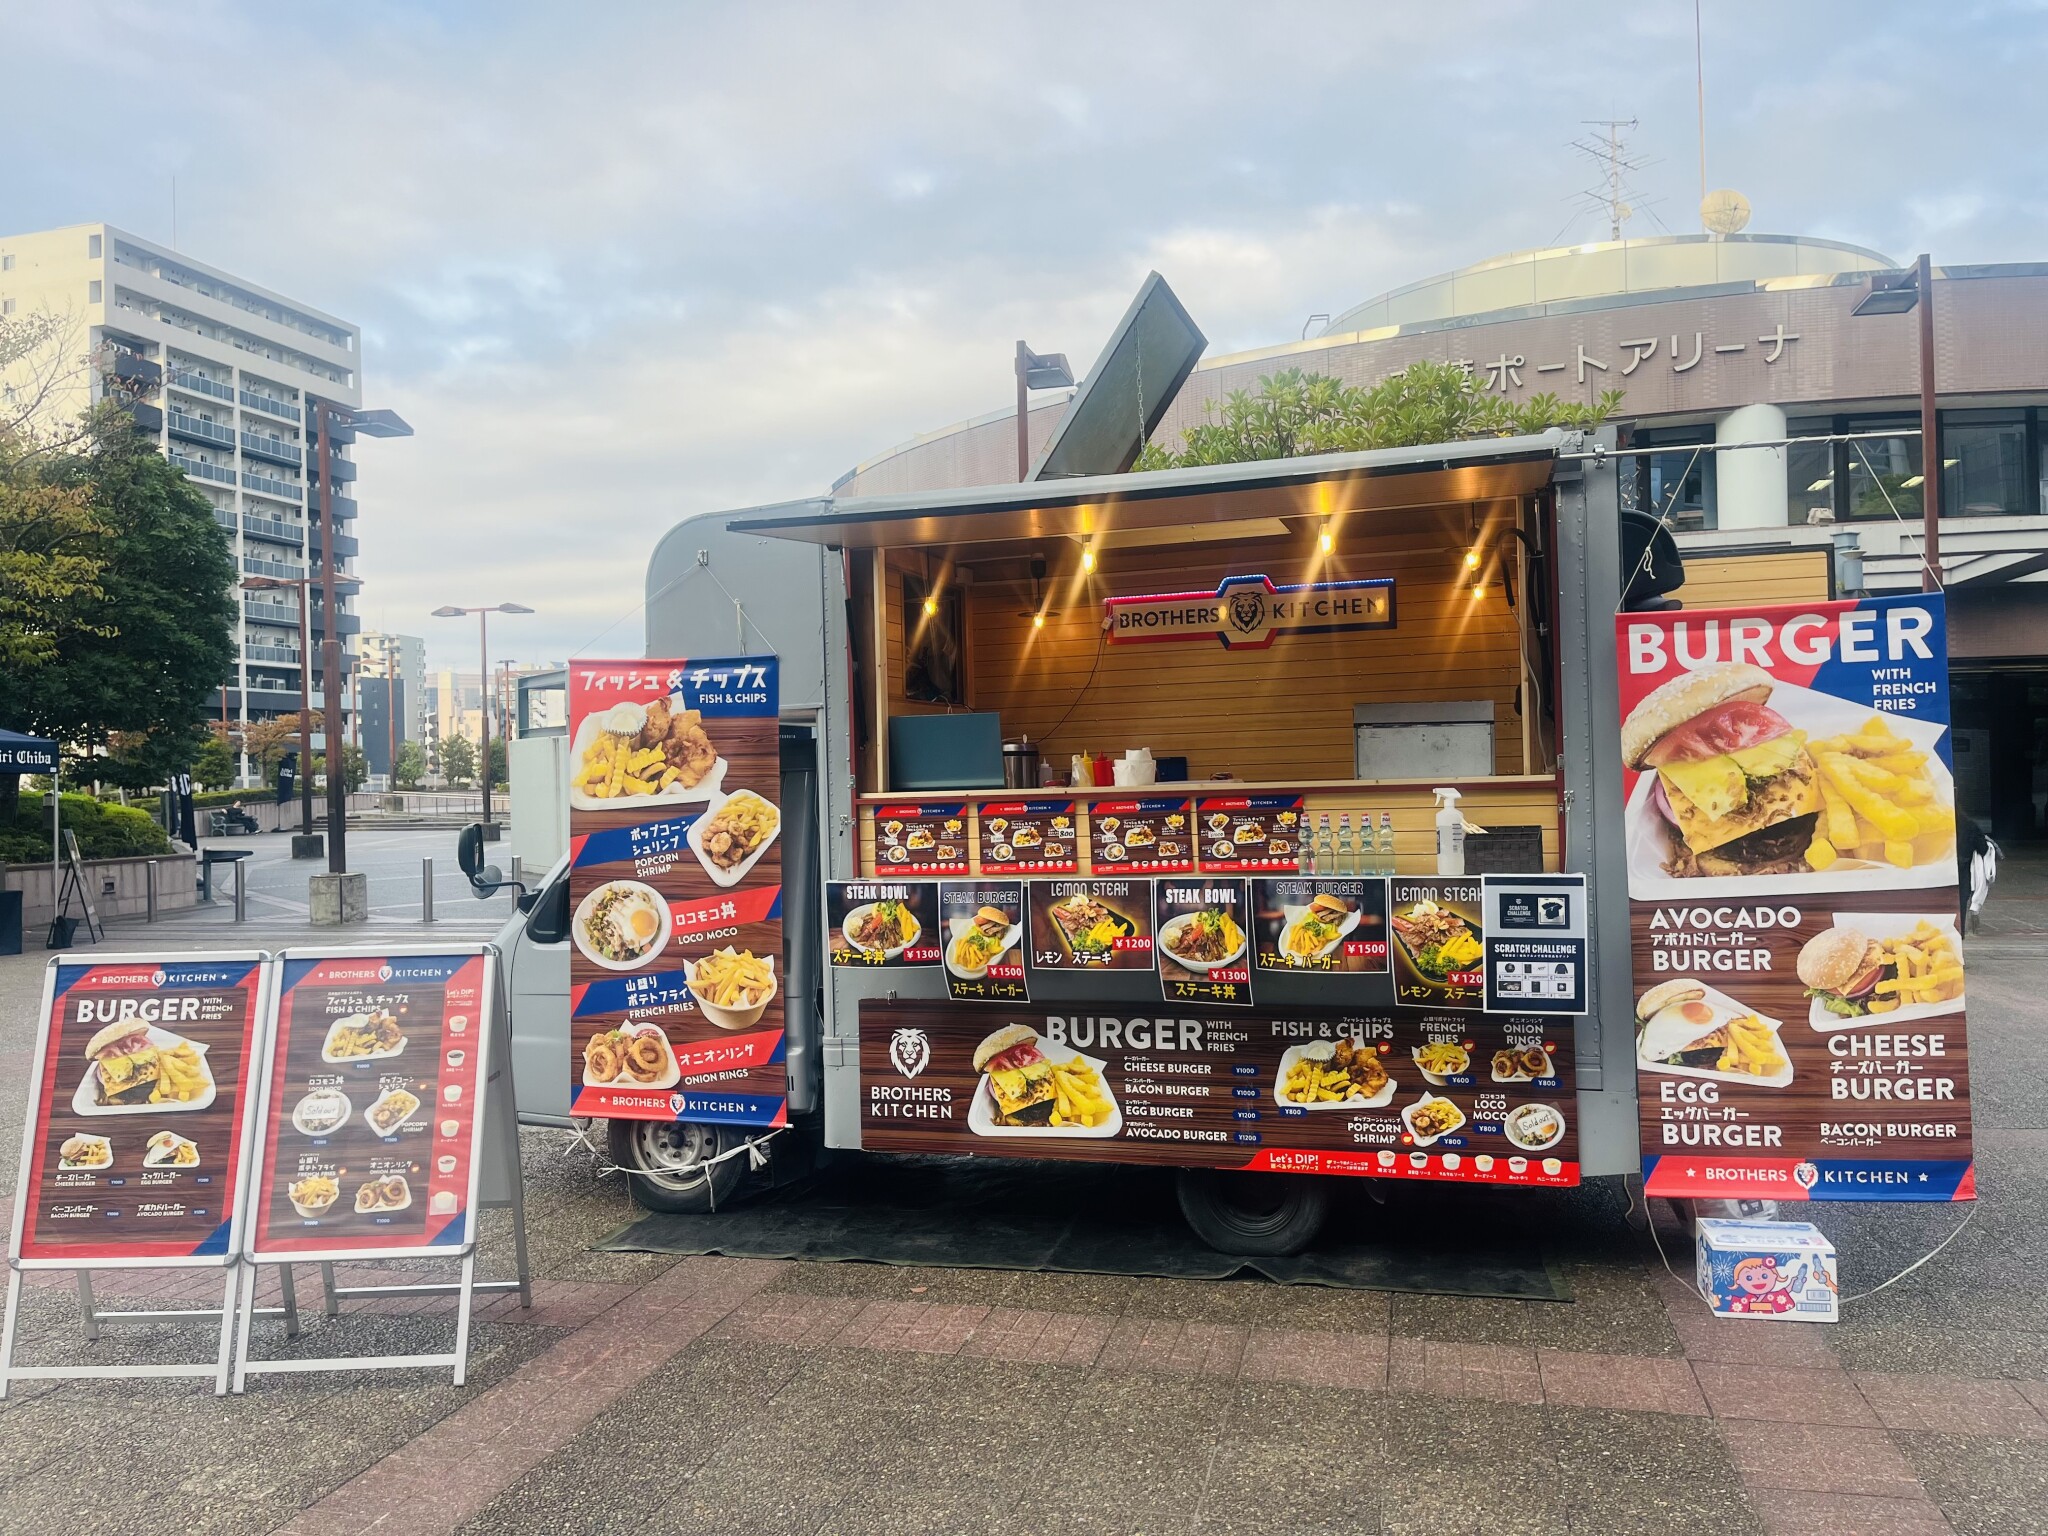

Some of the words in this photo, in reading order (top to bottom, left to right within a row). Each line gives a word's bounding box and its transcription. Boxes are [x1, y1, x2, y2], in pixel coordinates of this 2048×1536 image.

[1390, 324, 1799, 399] ポートアリーナ
[1119, 608, 1220, 629] BROTHERS
[1273, 597, 1384, 619] KITCHEN
[1628, 606, 1934, 674] BURGER
[580, 671, 660, 691] フィッシュ
[666, 669, 684, 689] &
[690, 665, 767, 689] チップス
[1871, 667, 1911, 681] WITH
[1872, 681, 1937, 696] FRENCH
[699, 694, 723, 704] FISH
[725, 694, 733, 703] &
[734, 693, 767, 703] CHIPS
[1873, 697, 1916, 711] FRIES
[16, 750, 52, 764] Chiba
[630, 820, 690, 841] ポップコーン
[633, 836, 680, 856] シュリンプ
[635, 852, 679, 868] POPCORN
[637, 864, 672, 878] SHRIMP
[846, 885, 878, 900] STEAK
[880, 886, 909, 900] BOWL
[1051, 882, 1087, 897] LEMON
[1093, 882, 1129, 897] STEAK
[1166, 888, 1202, 904] STEAK
[1204, 888, 1237, 904] BOWL
[1276, 882, 1313, 895] STEAK
[1315, 882, 1364, 895] BURGER
[943, 891, 975, 904] STEAK
[977, 891, 1019, 903] BURGER
[676, 901, 737, 926] ロコモコ丼
[1649, 906, 1802, 930] AVOCADO
[678, 933, 704, 944] LOCO
[706, 927, 738, 941] MOCO
[1650, 932, 1757, 947] アボカドバーガー
[1494, 943, 1531, 954] SCRATCH
[1532, 944, 1577, 954] CHALLENGE
[832, 949, 886, 965] ステーキ丼
[1036, 950, 1063, 964] レモン
[1072, 950, 1112, 965] ステーキ
[1259, 952, 1296, 969] ステーキ
[1302, 953, 1341, 970] バーガー
[1652, 949, 1772, 971] BURGER
[102, 975, 149, 984] BROTHERS
[168, 974, 217, 983] KITCHEN
[329, 970, 375, 979] BROTHERS
[395, 969, 442, 977] KITCHEN
[1451, 973, 1482, 983] ¥120
[626, 976, 658, 992] 山盛り
[953, 983, 985, 996] ステーキ
[991, 984, 1024, 997] バーガー
[1175, 983, 1236, 1000] ステーキ丼
[1400, 985, 1431, 998] レモン
[327, 994, 364, 1005] フィッシュ
[366, 994, 374, 1004] &
[376, 994, 409, 1004] チップス
[628, 986, 688, 1007] ポテトフライ
[76, 997, 200, 1023] BURGER
[202, 1004, 233, 1012] FRENCH
[326, 1006, 345, 1014] FISH
[346, 1005, 354, 1013] &
[355, 1005, 382, 1013] CHIPS
[629, 1006, 667, 1020] FRENCH
[668, 1001, 695, 1014] FRIES
[201, 1012, 222, 1020] FRIES
[1206, 1020, 1232, 1030] WITH
[1271, 1021, 1313, 1036] FISH
[1318, 1022, 1332, 1037] &
[1336, 1022, 1394, 1039] CHIPS
[1420, 1022, 1466, 1033] FRENCH
[1503, 1024, 1544, 1034] ONION
[1046, 1017, 1204, 1051] BURGER
[1206, 1031, 1248, 1042] FRENCH
[1428, 1034, 1459, 1043] FRIES
[1506, 1035, 1542, 1045] RINGS
[1207, 1042, 1235, 1052] FRIES
[1828, 1034, 1946, 1057] CHEESE
[679, 1043, 755, 1067] オニオンリング
[1124, 1062, 1165, 1073] CHEESE
[1167, 1064, 1212, 1074] BURGER
[1830, 1061, 1924, 1075] チーズバーガー
[684, 1073, 718, 1086] ONION
[719, 1068, 749, 1081] RINGS
[871, 1086, 951, 1102] BROTHERS
[1125, 1084, 1163, 1095] BACON
[1166, 1085, 1210, 1096] BURGER
[1660, 1081, 1719, 1104] EGG
[1831, 1078, 1955, 1101] BURGER
[304, 1104, 322, 1115] Sold
[612, 1096, 666, 1109] BROTHERS
[689, 1101, 744, 1112] KITCHEN
[871, 1104, 953, 1119] KITCHEN
[1474, 1100, 1507, 1109] LOCO
[1126, 1106, 1148, 1116] EGG
[1149, 1107, 1194, 1118] BURGER
[1473, 1111, 1509, 1121] MOCO
[1660, 1107, 1749, 1121] エッグバーガー
[1347, 1122, 1402, 1134] POPCORN
[1522, 1117, 1539, 1131] Sold
[1539, 1114, 1551, 1124] out
[1126, 1128, 1181, 1139] AVOCADO
[1183, 1130, 1228, 1141] BURGER
[1662, 1124, 1782, 1147] BURGER
[1820, 1123, 1882, 1137] BACON
[1887, 1124, 1957, 1138] BURGER
[1353, 1134, 1396, 1144] SHRIMP
[1820, 1138, 1881, 1147] ベーコンバーガー
[1295, 1154, 1319, 1165] DIP!
[1705, 1167, 1788, 1182] BROTHERS
[1824, 1171, 1909, 1184] KITCHEN
